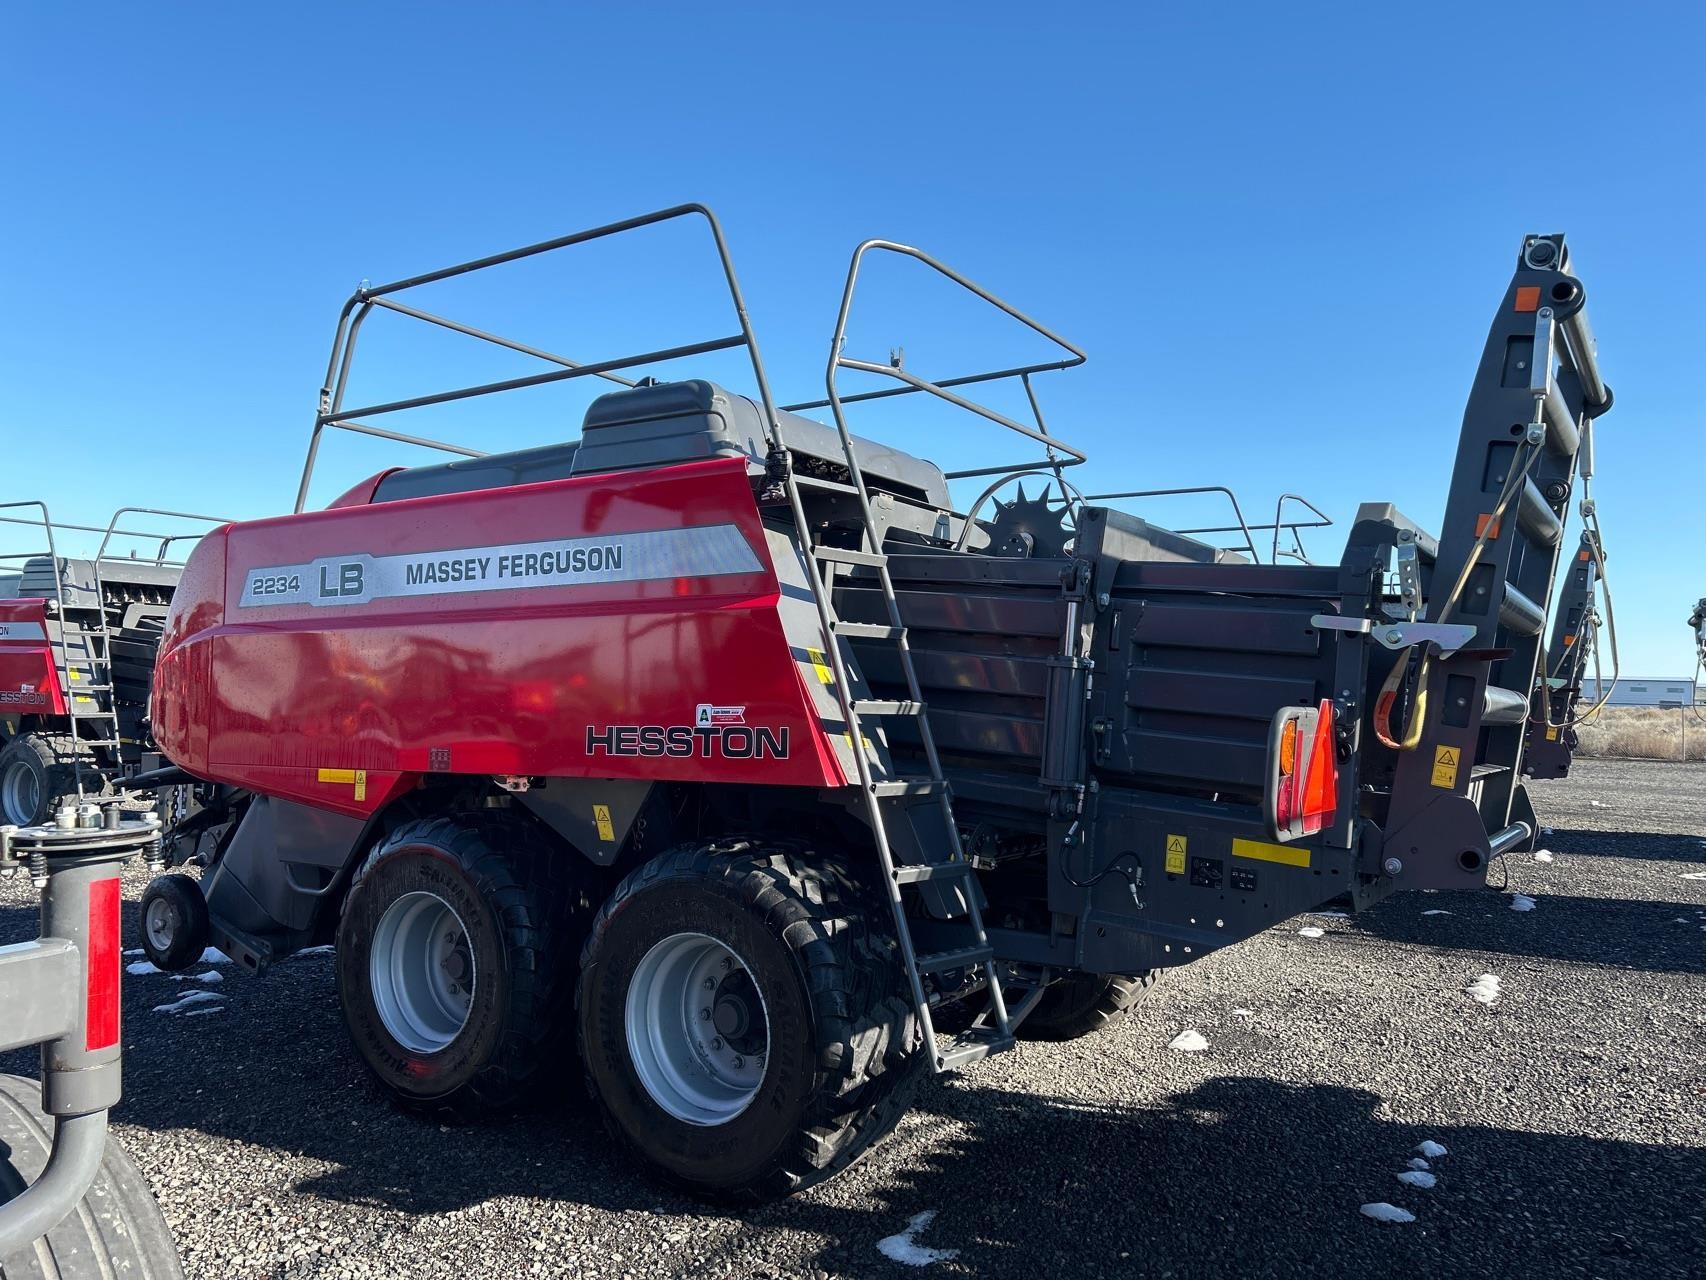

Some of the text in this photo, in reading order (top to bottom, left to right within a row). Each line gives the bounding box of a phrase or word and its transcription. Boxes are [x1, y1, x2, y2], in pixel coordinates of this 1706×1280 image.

[252, 545, 623, 598] 2234 LB MASSEY FERGUSON
[586, 725, 790, 760] HESSTON
